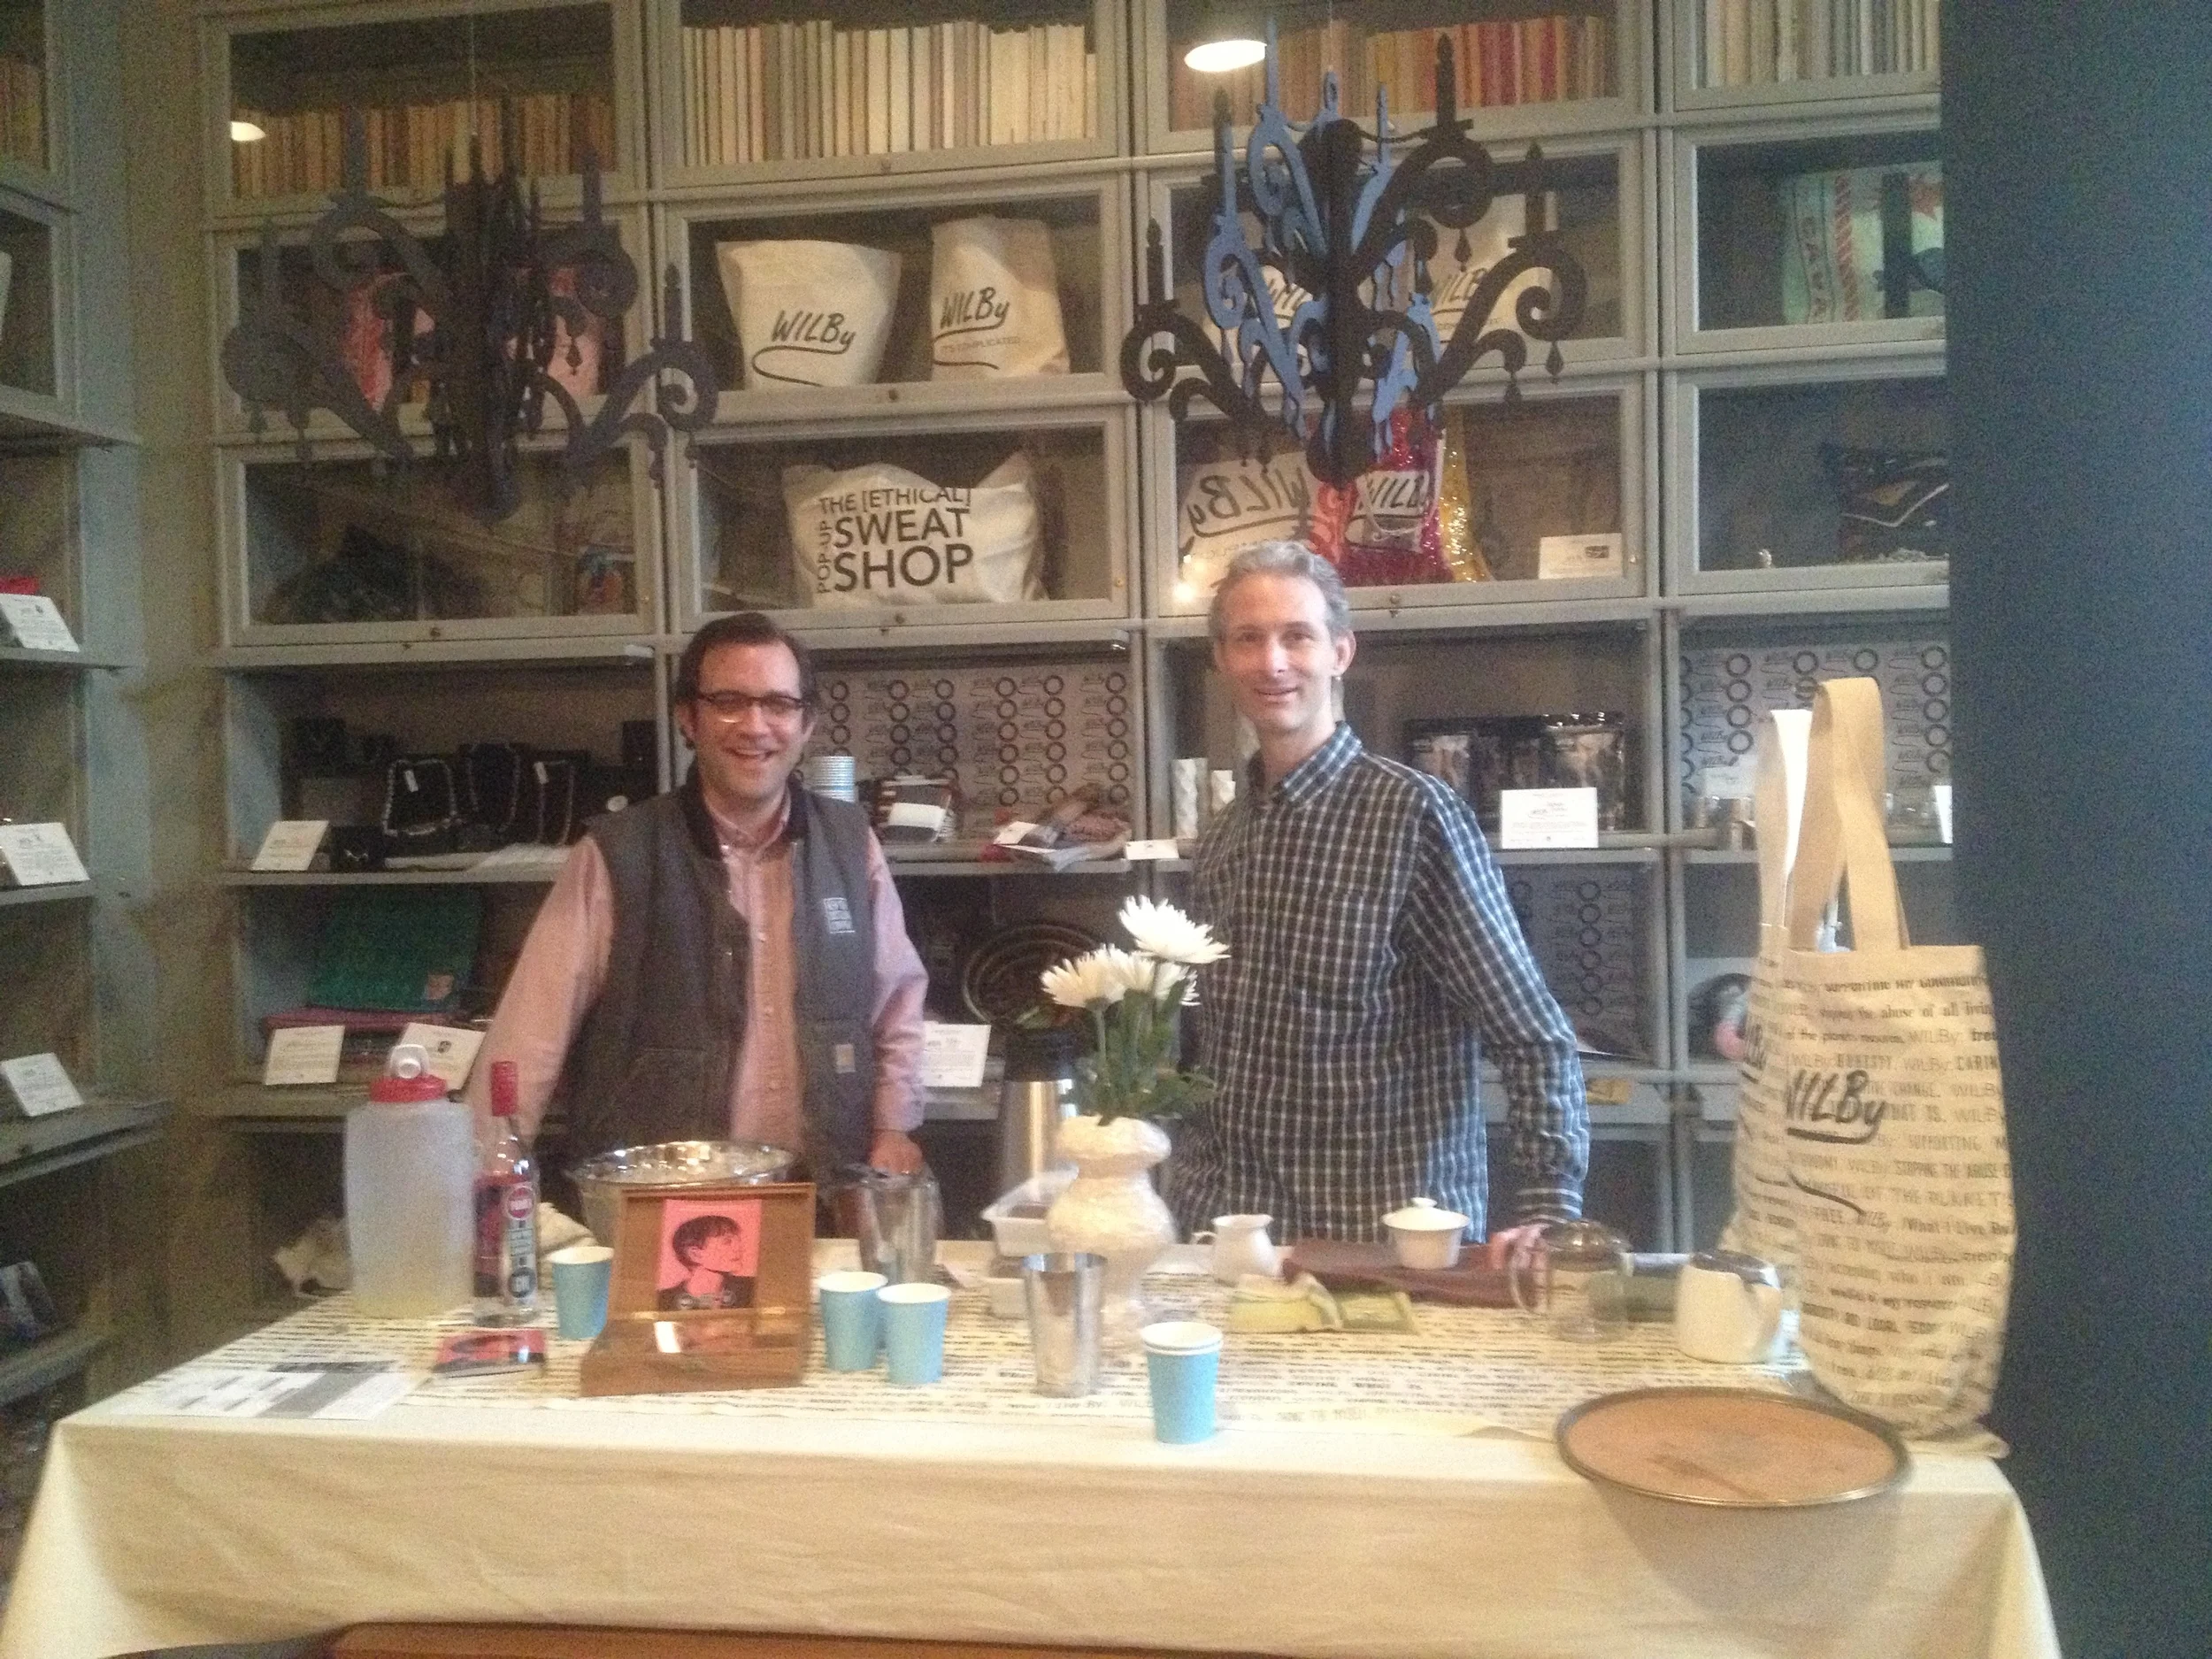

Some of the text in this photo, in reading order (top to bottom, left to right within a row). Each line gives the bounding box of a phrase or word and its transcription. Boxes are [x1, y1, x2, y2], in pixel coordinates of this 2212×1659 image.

[940, 287, 1010, 328] WILBy
[770, 310, 856, 351] WILBy
[818, 493, 856, 514] THE
[833, 507, 971, 549] SWEAT
[833, 543, 974, 592] SHOP
[1881, 1004, 1915, 1018] abuse
[1922, 1002, 1936, 1018] of
[1942, 1001, 1959, 1017] all
